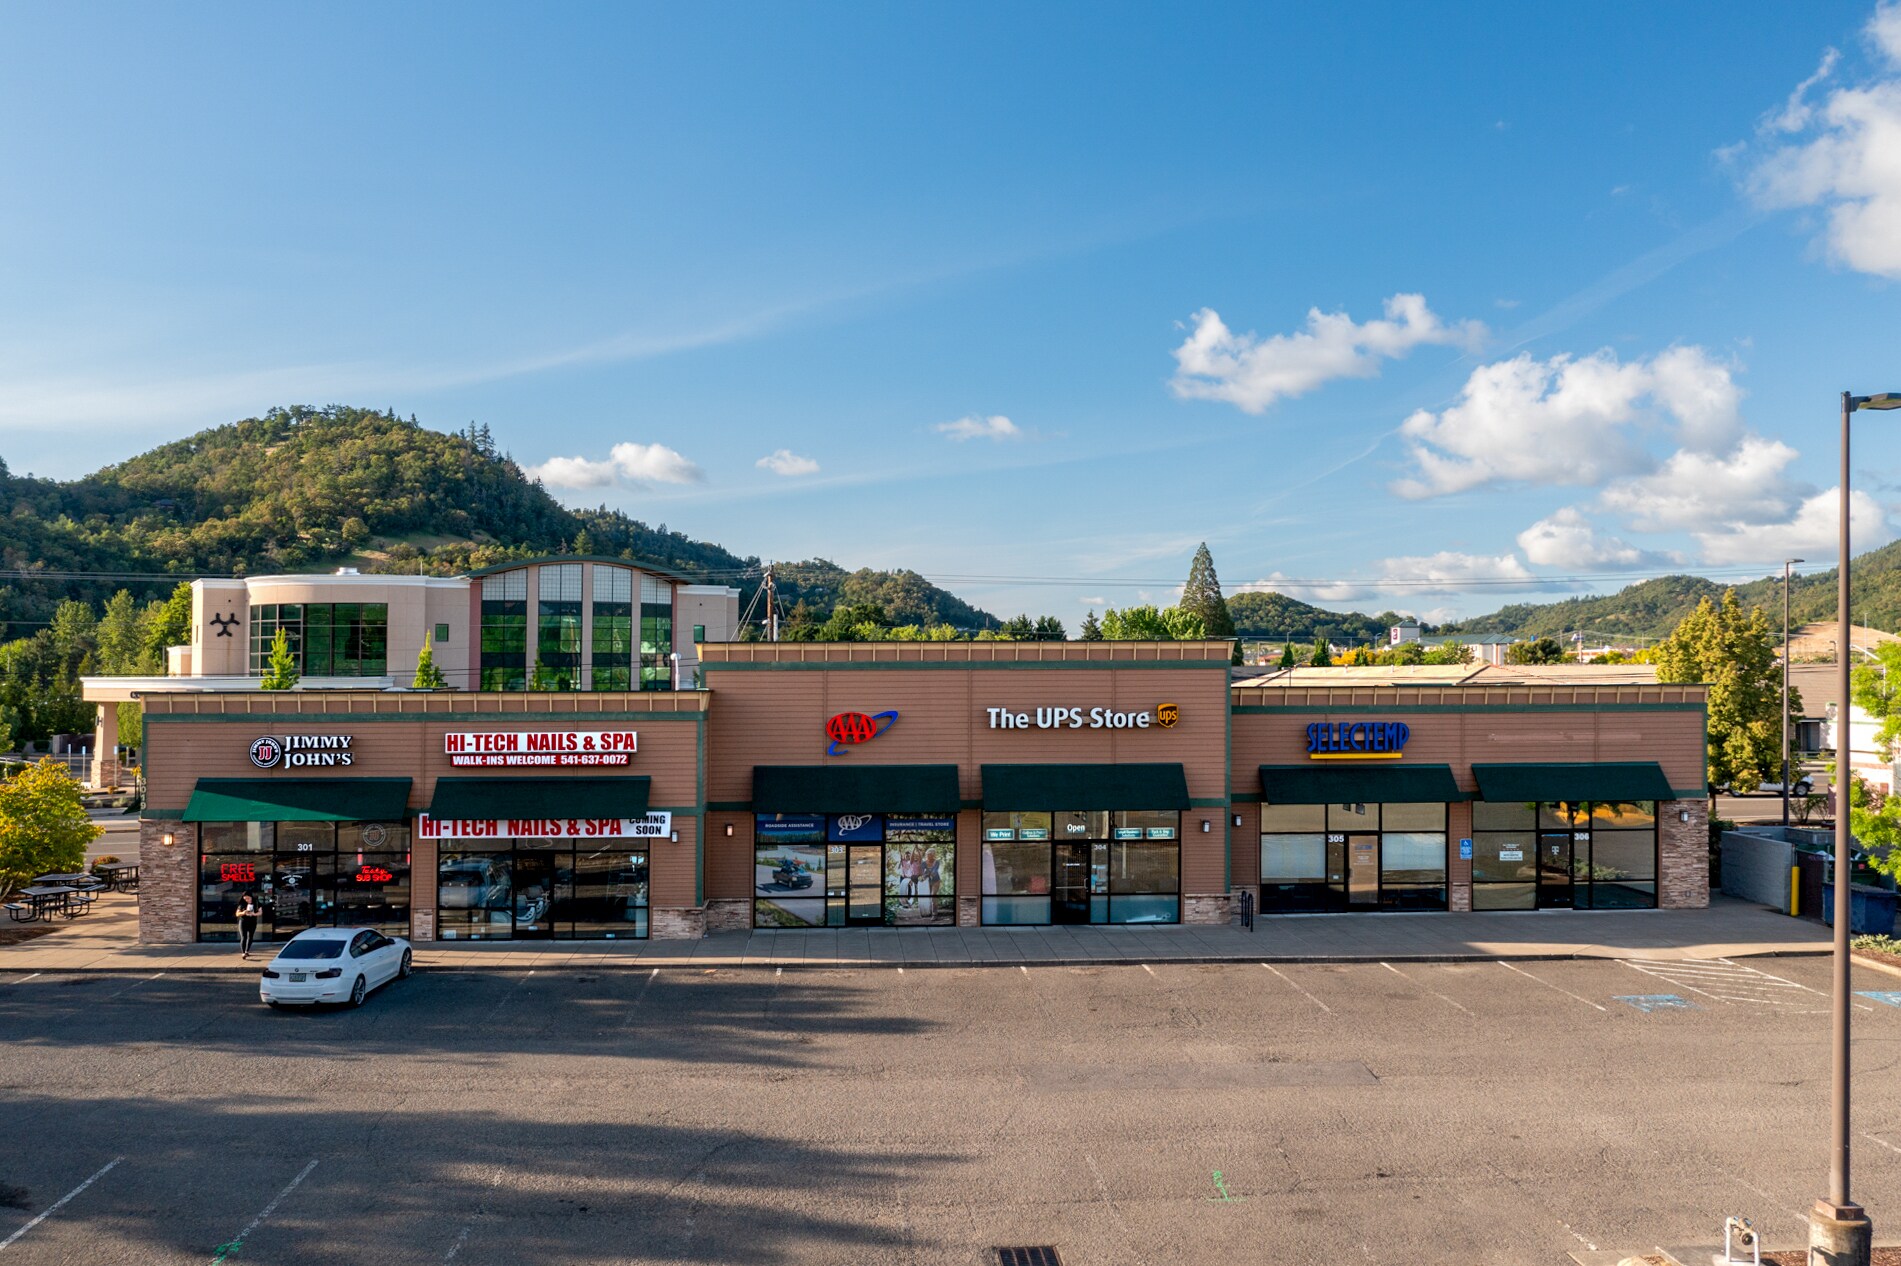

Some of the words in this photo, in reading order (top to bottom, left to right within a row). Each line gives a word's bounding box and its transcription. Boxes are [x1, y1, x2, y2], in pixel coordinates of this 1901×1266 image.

[987, 707, 1029, 729] The
[1036, 707, 1083, 729] UPS
[1089, 707, 1149, 729] Store
[1160, 710, 1177, 724] ups
[827, 711, 876, 744] AAA
[284, 736, 352, 751] JIMMY
[446, 734, 518, 752] HI-TECH
[527, 733, 578, 751] NAILS
[583, 735, 596, 750] &
[600, 733, 635, 750] SPA
[1307, 722, 1410, 752] SELECTEMP
[259, 746, 272, 760] JJ
[453, 755, 505, 765] WALK-INS
[506, 755, 557, 765] WELCOME
[560, 754, 628, 765] 541-637-0072
[284, 753, 352, 769] JOHN'S
[421, 815, 497, 836] HI-TECH
[507, 819, 562, 836] NAILS
[566, 819, 581, 836] &
[585, 819, 622, 836] SPA
[636, 825, 662, 834] SOON
[838, 814, 862, 831] AAA
[1067, 823, 1086, 833] Open
[1574, 832, 1590, 840] 306
[297, 843, 313, 851] 301
[221, 863, 255, 874] FREE
[221, 873, 256, 882] SMELLS
[355, 873, 371, 882] SUB
[372, 873, 392, 882] SHOP
